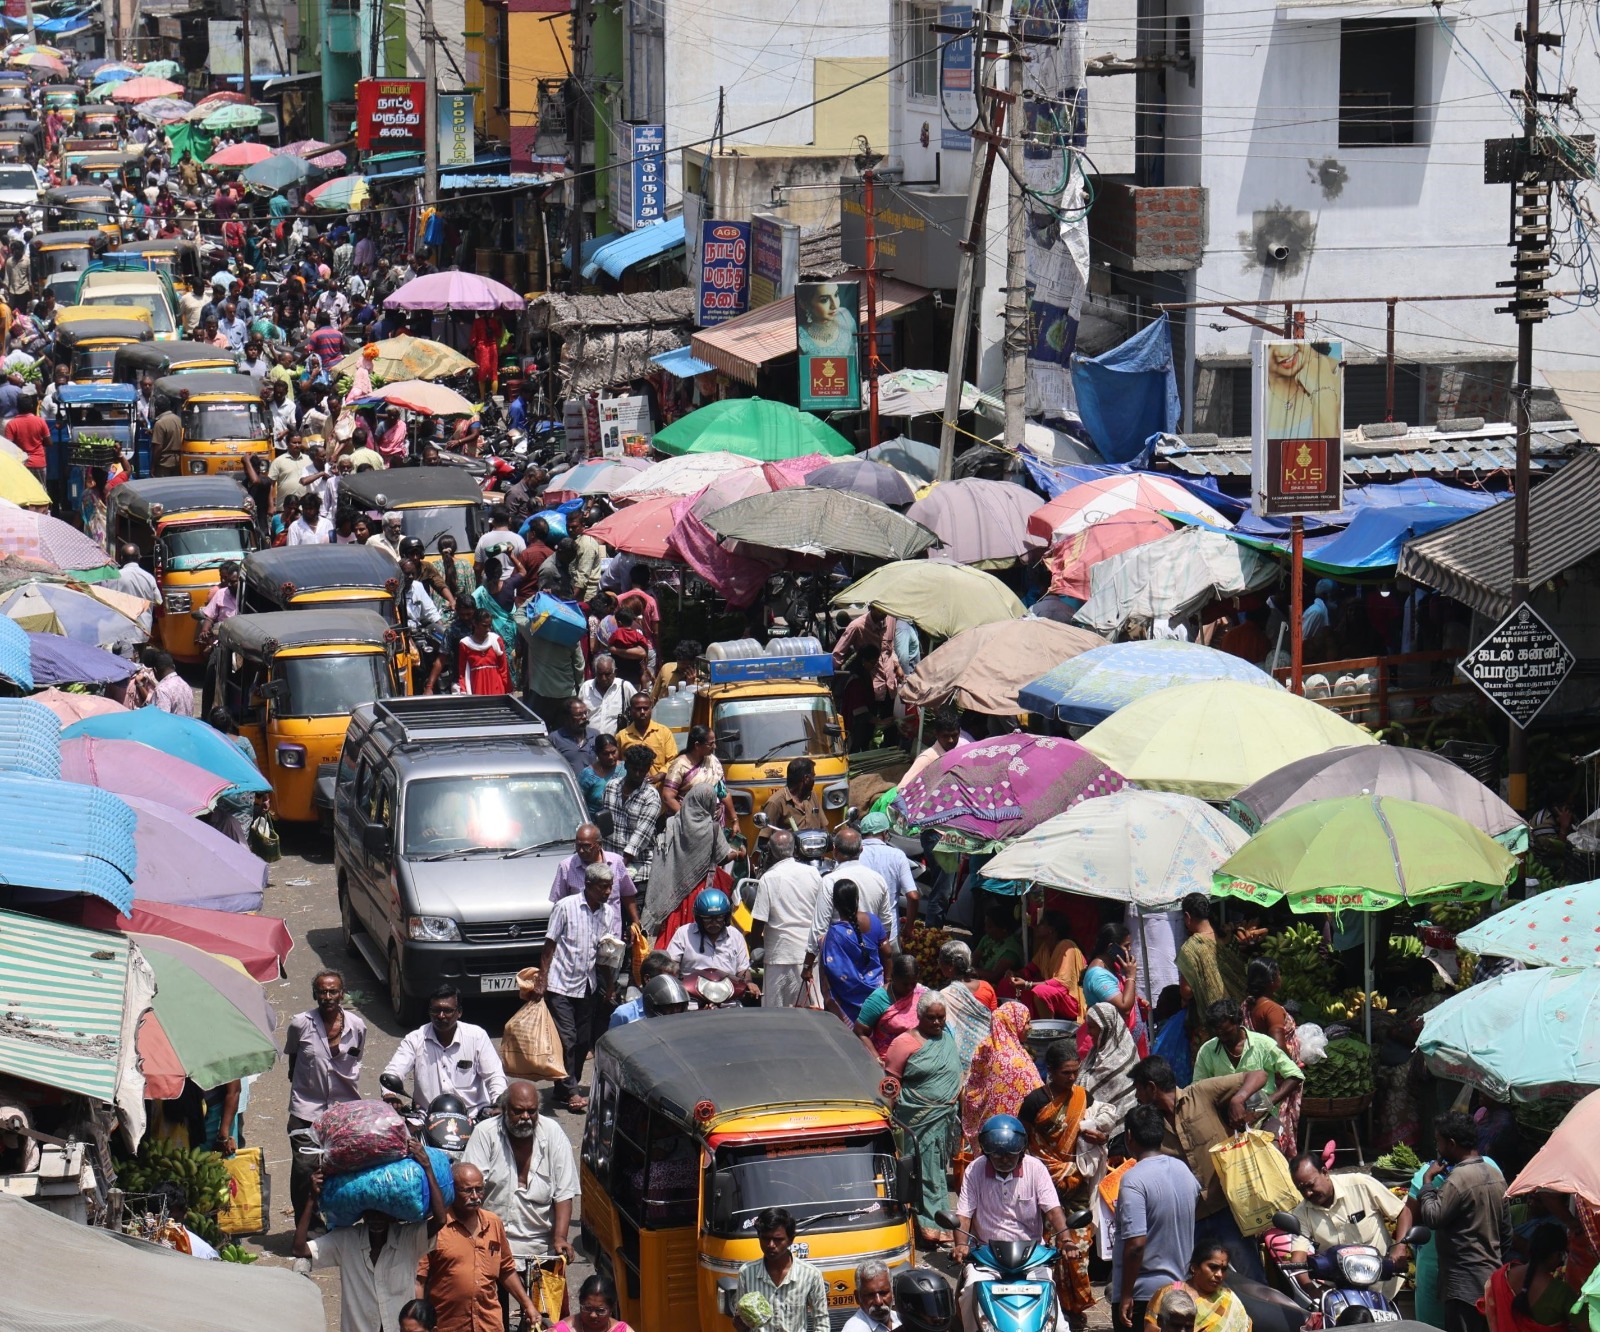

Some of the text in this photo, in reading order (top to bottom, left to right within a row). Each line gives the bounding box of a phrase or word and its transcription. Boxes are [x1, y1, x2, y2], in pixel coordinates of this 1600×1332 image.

[377, 97, 414, 109] நாட்டு
[372, 110, 420, 125] மருந்து
[379, 127, 413, 137] கடை
[453, 101, 466, 158] POPULAR
[716, 229, 738, 237] AGS
[704, 239, 746, 265] நாட்டு
[704, 264, 745, 291] மருந்து
[703, 292, 744, 308] கடை
[814, 378, 845, 388] KJS
[1285, 468, 1322, 480] KJS
[1478, 642, 1560, 662] கடல் கன்னி
[1474, 657, 1566, 682] பொருட்காட்சி
[1502, 696, 1540, 706] சேலம்
[788, 1242, 809, 1253] pe
[833, 1296, 853, 1305] 3079
